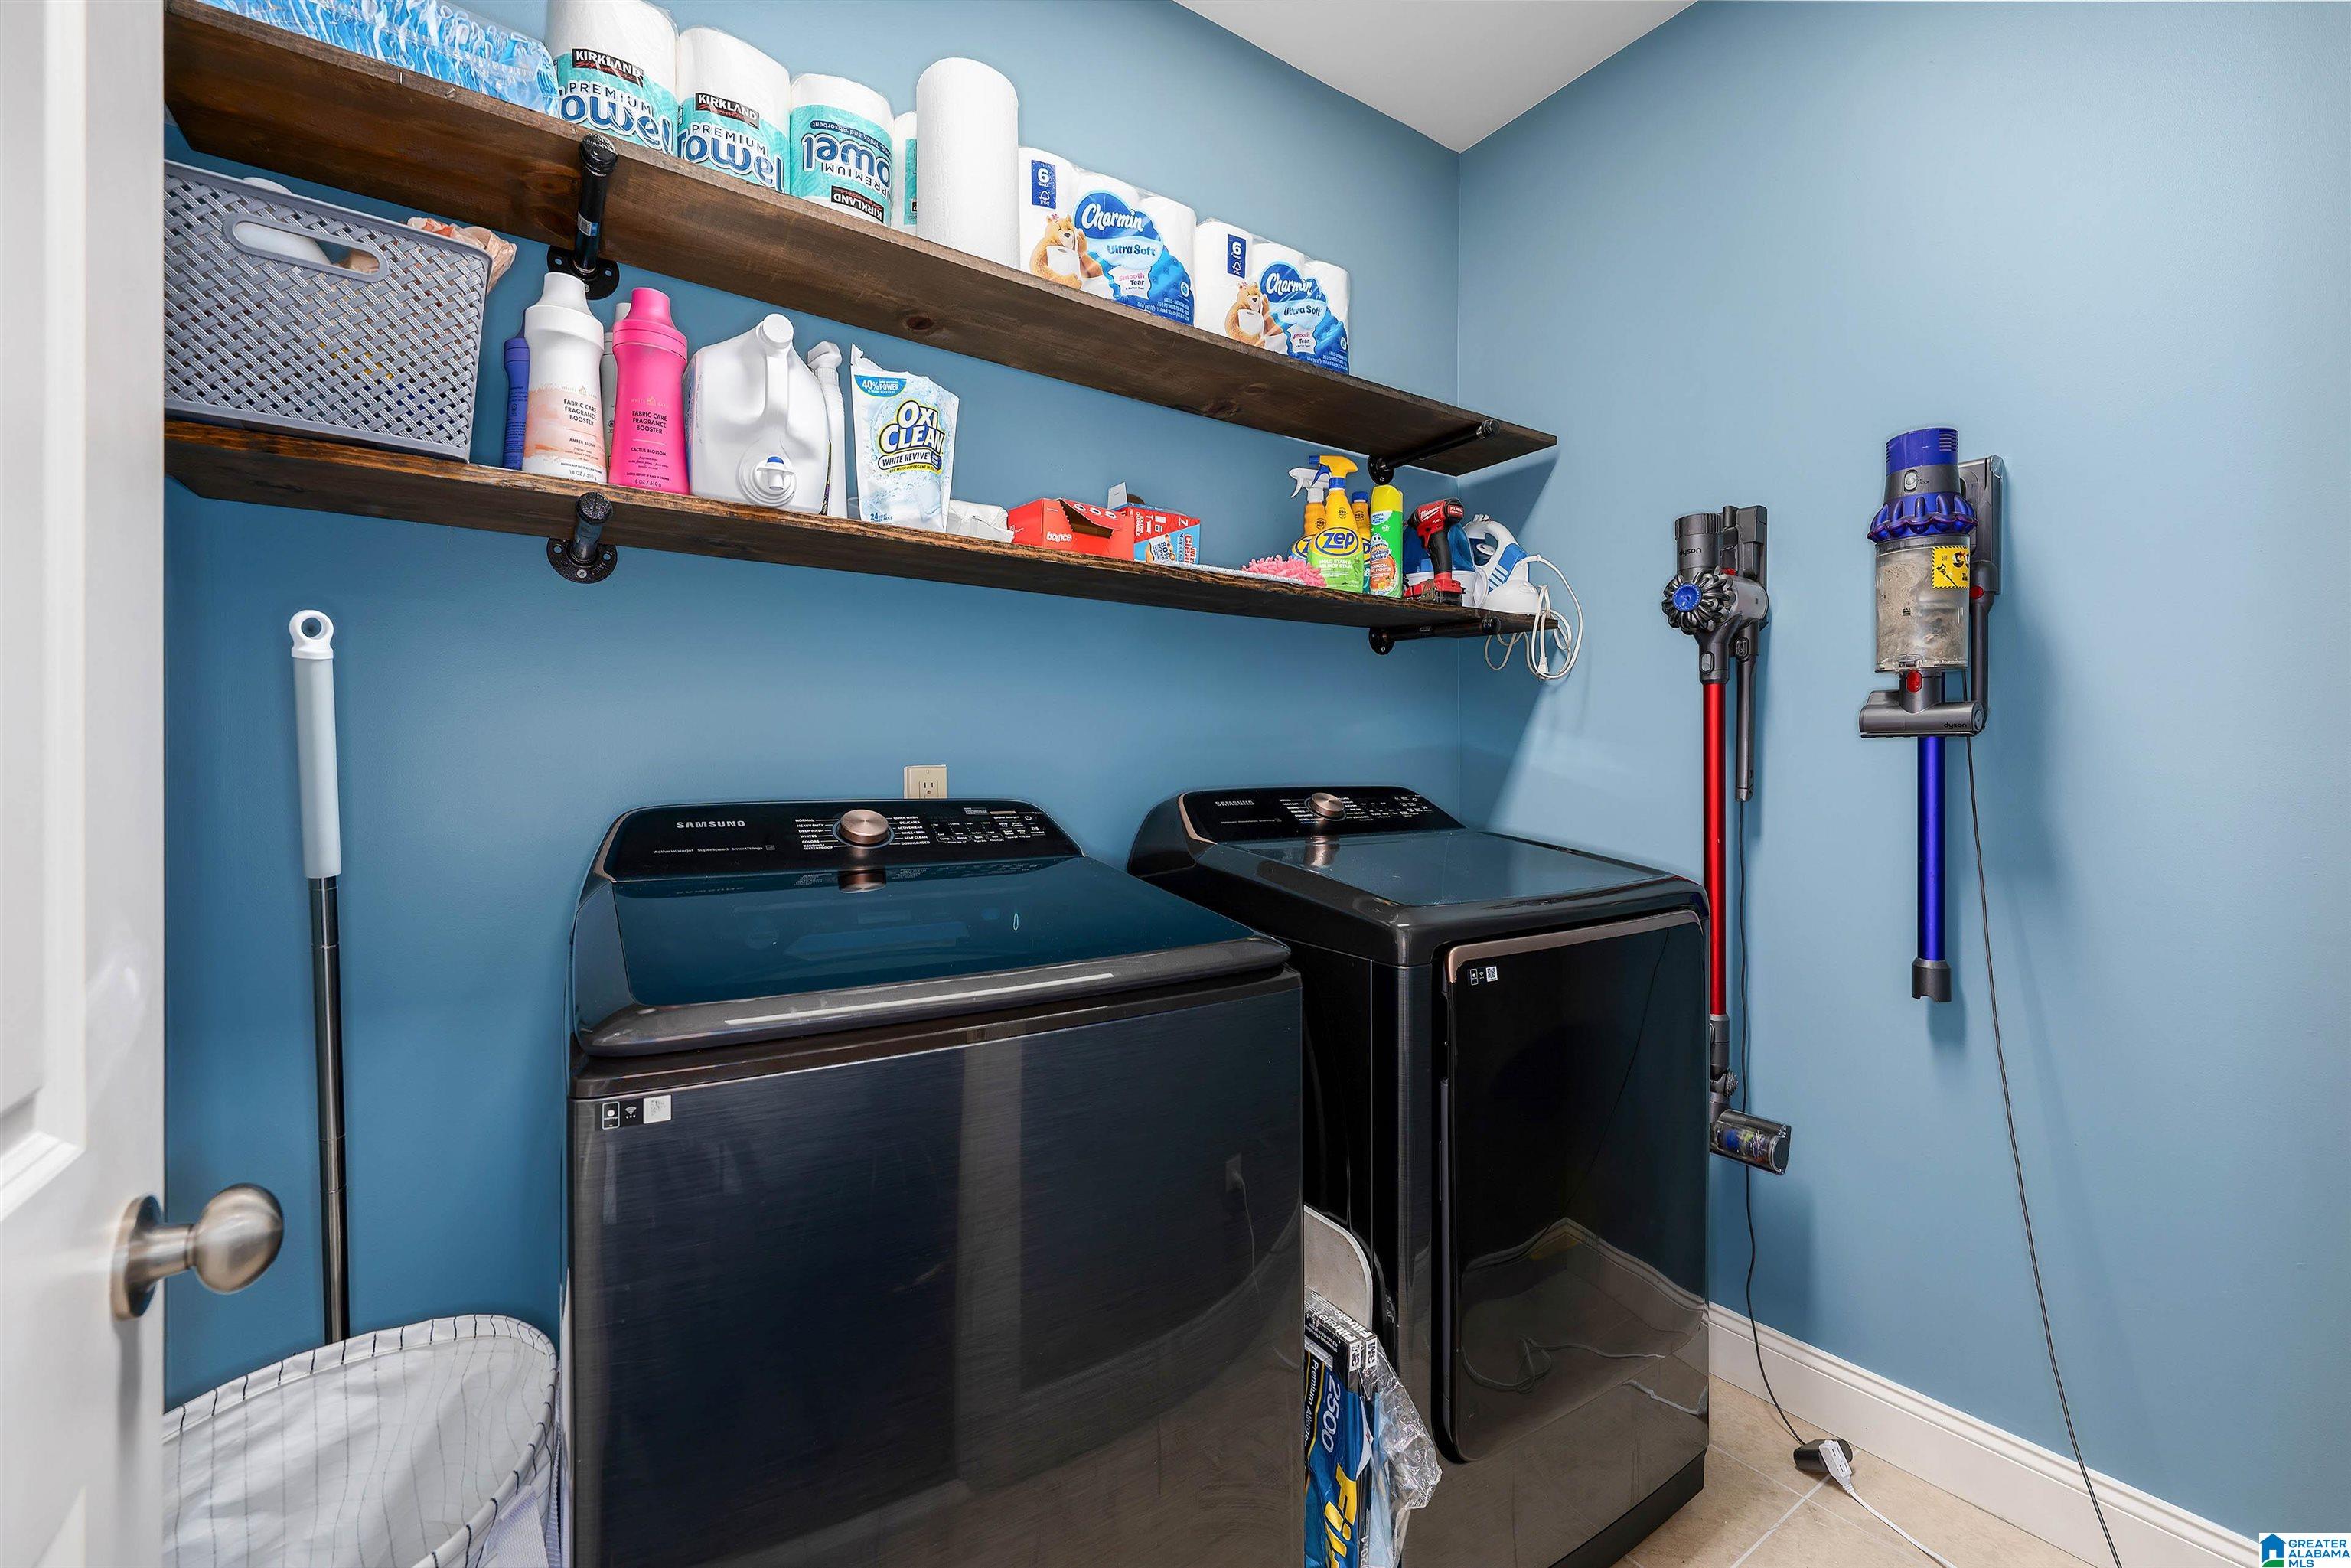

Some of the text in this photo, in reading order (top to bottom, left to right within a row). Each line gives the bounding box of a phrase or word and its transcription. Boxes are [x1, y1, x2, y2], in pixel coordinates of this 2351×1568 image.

[576, 51, 642, 77] KIRKLAND
[569, 83, 650, 113] PREMIUM
[698, 94, 757, 120] KIRKLAND
[560, 94, 673, 155] owel
[692, 125, 765, 155] PREMIUM
[825, 164, 888, 197] PREMIUM
[1037, 168, 1050, 183] 6
[833, 193, 884, 220] KIRKLAND
[1081, 203, 1144, 232] Charmin
[1107, 244, 1156, 256] Ultra Soft
[1232, 241, 1242, 256] 6
[1119, 272, 1145, 282] Smooth
[1266, 273, 1312, 296] Charmin
[1283, 305, 1322, 316] Ultra Soft
[862, 380, 879, 390] 40%
[563, 399, 597, 413] FABRIC CARE
[565, 406, 597, 420] FRAGRANCE
[569, 415, 594, 426] BOOSTER
[653, 413, 667, 422] CARE
[898, 400, 938, 429] OXI
[632, 418, 667, 429] FRAGRANCE
[636, 425, 663, 435] BOOSTER
[880, 423, 945, 455] CLEAN
[882, 452, 928, 466] WHITE REVIVE
[870, 512, 879, 520] 24
[1160, 542, 1169, 560] 80%
[1679, 547, 1702, 557] dyson
[676, 820, 745, 829] SAMSUNG
[1319, 1314, 1358, 1342] Filtrete
[1334, 1309, 1373, 1338] Filtrete
[1308, 1358, 1319, 1406] Premium
[1321, 1374, 1341, 1453] 2500
